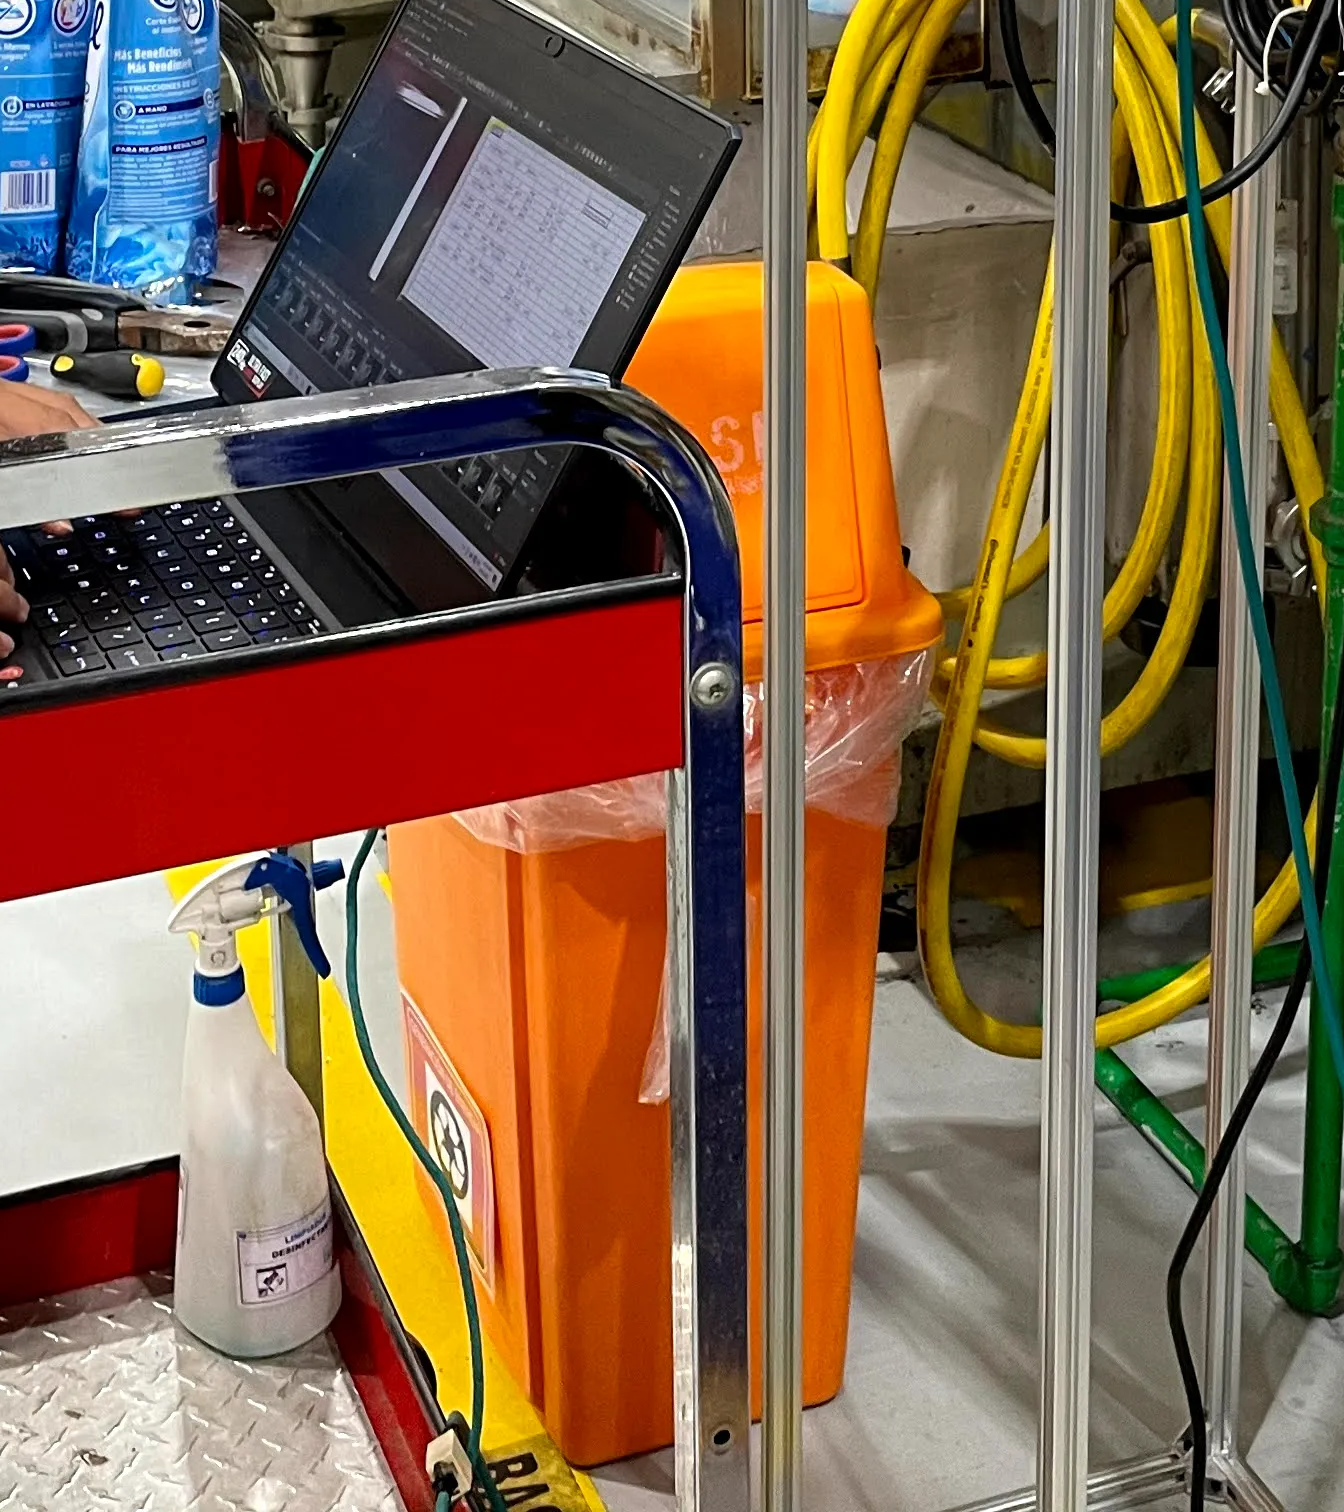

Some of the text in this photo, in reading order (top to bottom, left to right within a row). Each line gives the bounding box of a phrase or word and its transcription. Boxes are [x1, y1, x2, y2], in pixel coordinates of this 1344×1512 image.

[113, 47, 182, 62] Más Beneficios
[127, 61, 146, 74] Más
